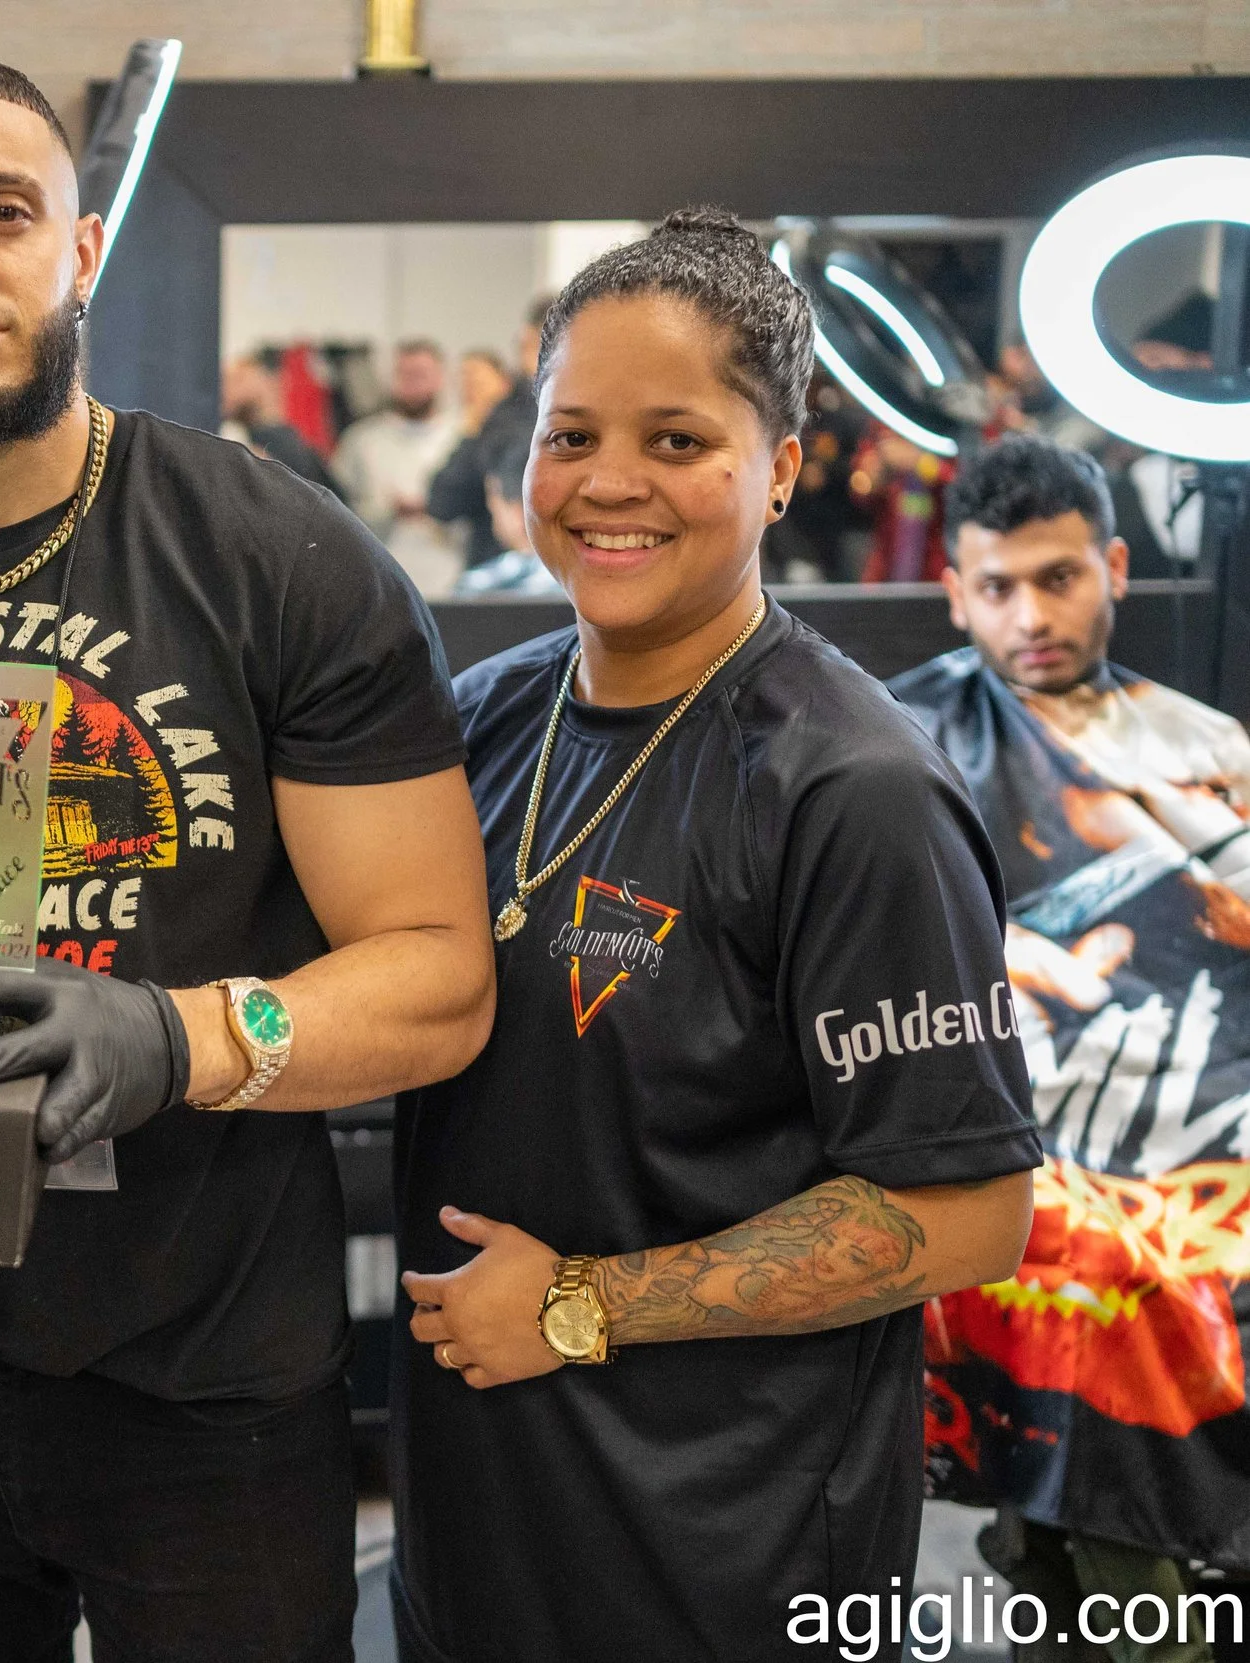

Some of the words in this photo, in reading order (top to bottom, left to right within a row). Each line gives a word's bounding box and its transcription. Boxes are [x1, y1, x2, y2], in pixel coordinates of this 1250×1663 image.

[134, 683, 235, 852] LAKE
[83, 836, 118, 864] FRIDAY
[118, 837, 136, 856] THE
[815, 991, 986, 1083] Golden
